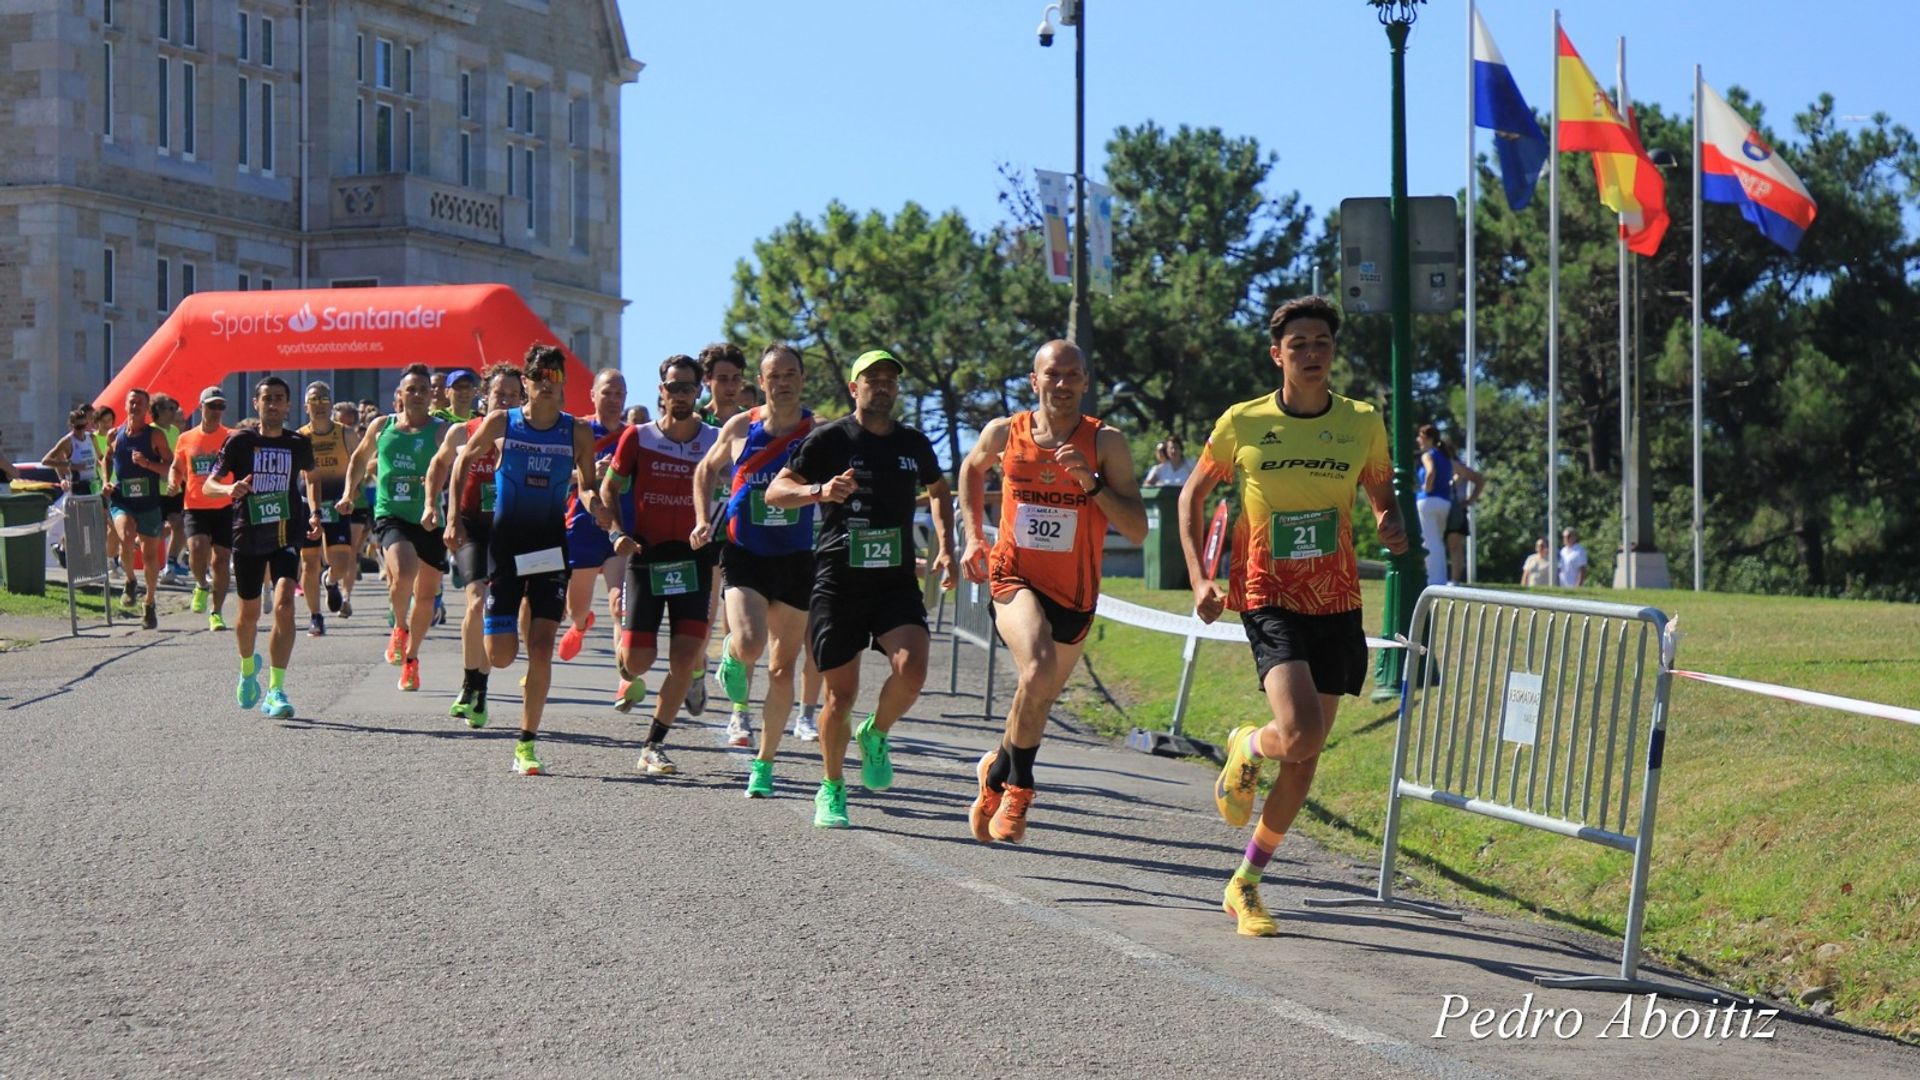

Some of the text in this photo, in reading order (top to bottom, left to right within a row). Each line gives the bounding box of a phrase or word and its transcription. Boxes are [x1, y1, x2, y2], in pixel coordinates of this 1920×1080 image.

[211, 305, 446, 341] Sports Santander
[277, 340, 384, 356] sportssantander.es
[528, 456, 552, 472] RUIZ
[651, 460, 690, 473] GETXO
[898, 456, 918, 472] 314
[1260, 457, 1350, 471] españa
[130, 483, 141, 493] 90
[395, 483, 409, 493] 80
[1013, 490, 1087, 506] REINOSA
[258, 502, 281, 515] 106
[1027, 518, 1061, 538] 302
[1293, 525, 1316, 544] 21
[862, 543, 891, 558] 124
[665, 571, 683, 584] 42
